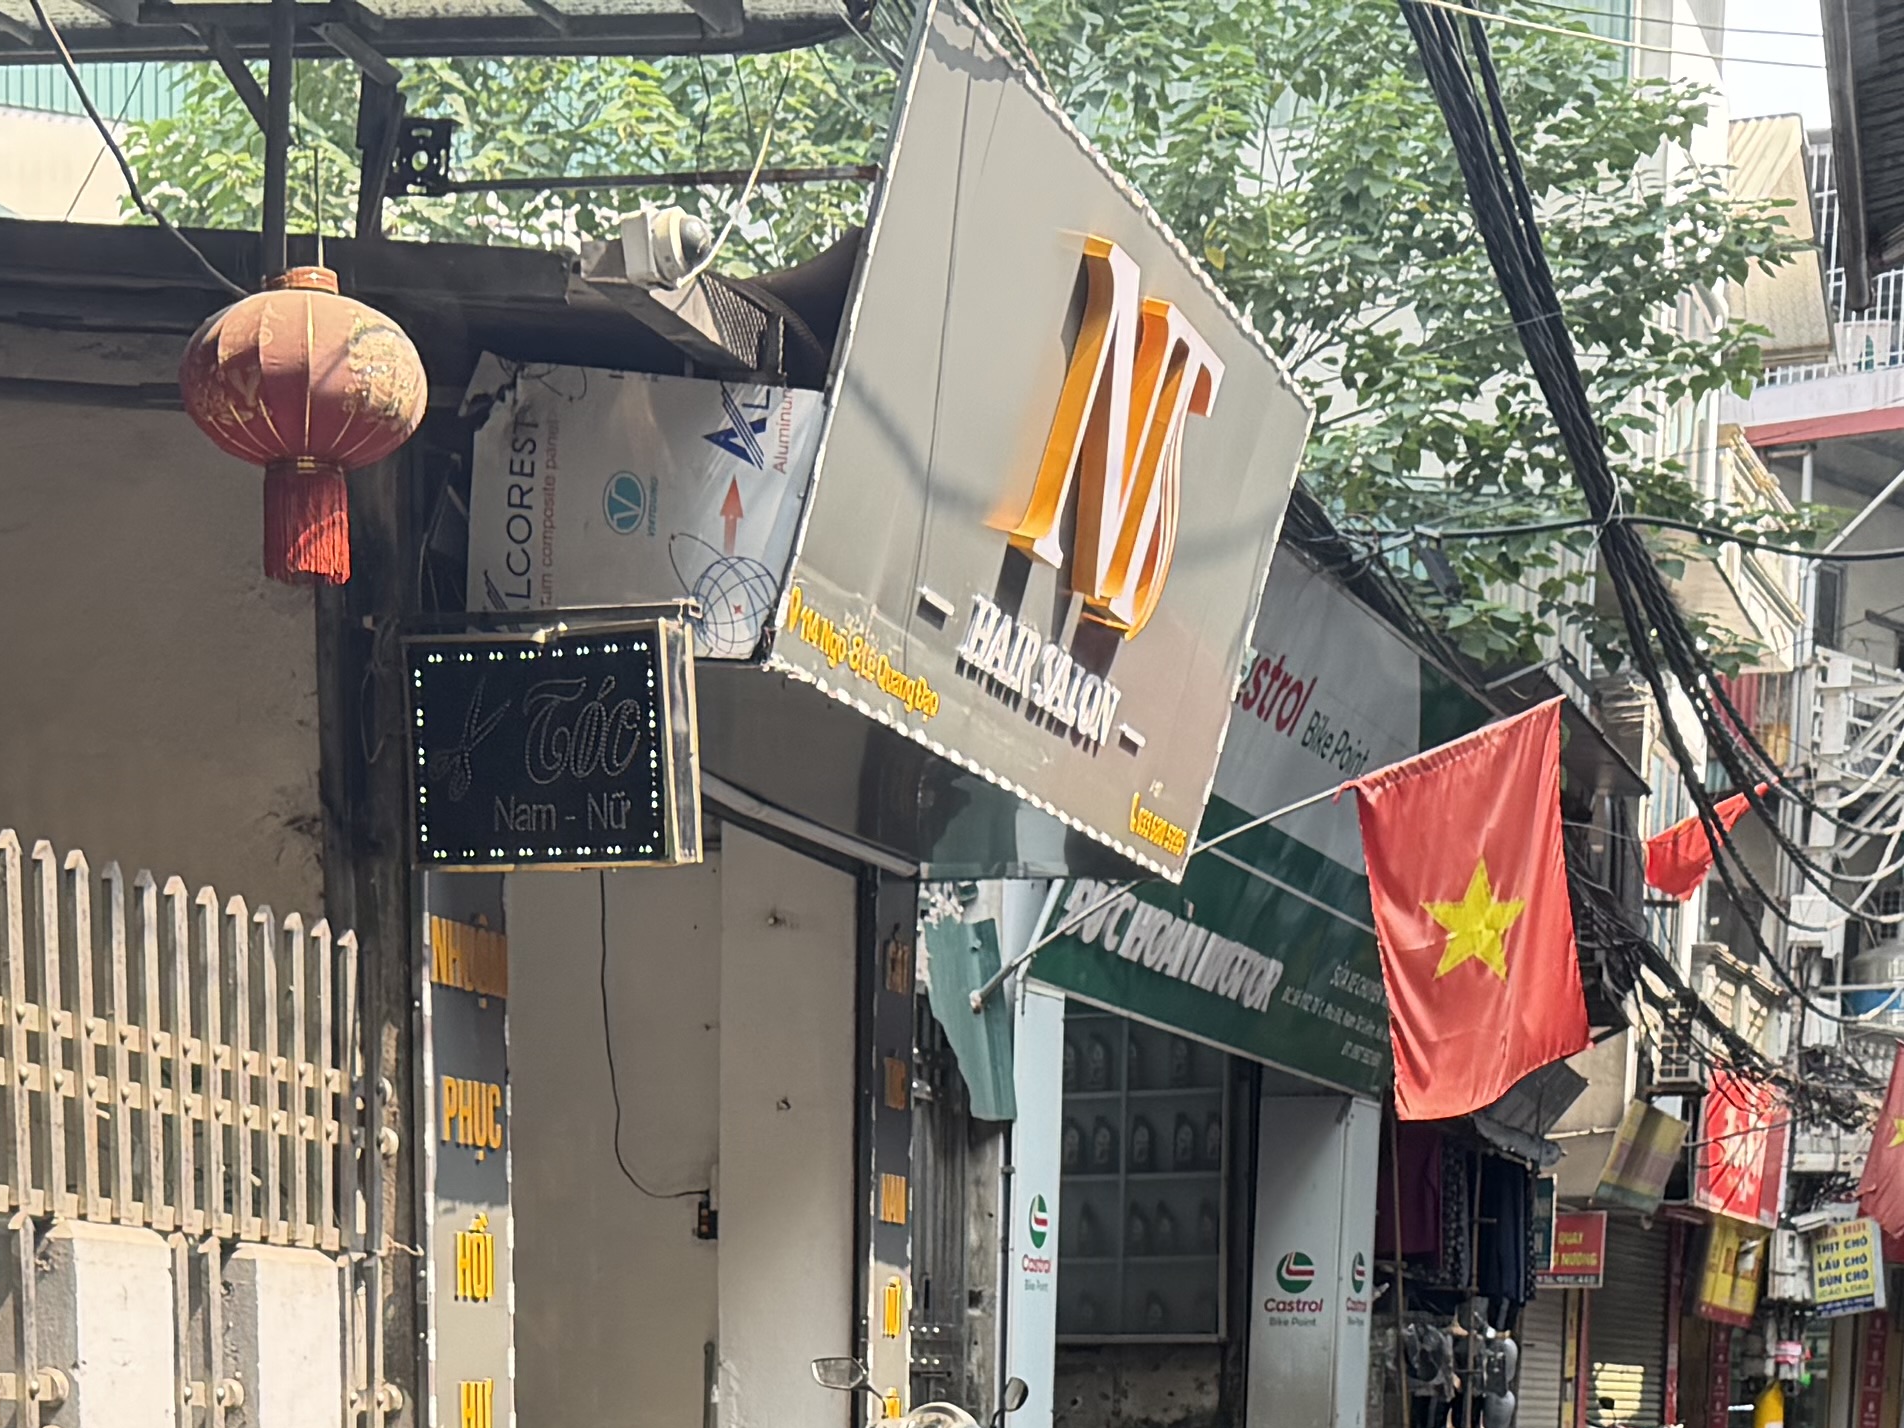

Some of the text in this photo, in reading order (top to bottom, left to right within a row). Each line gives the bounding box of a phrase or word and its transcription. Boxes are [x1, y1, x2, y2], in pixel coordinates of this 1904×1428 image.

[958, 594, 1122, 747] HAIR SALON
[523, 674, 641, 785] Tóc
[1233, 655, 1370, 779] strol Bike Point
[495, 794, 556, 831] Nam
[588, 791, 631, 831] Nữ
[1190, 931, 1284, 1013] MOTOR
[440, 1074, 502, 1162] PHỤC
[1263, 1297, 1323, 1312] Castrol
